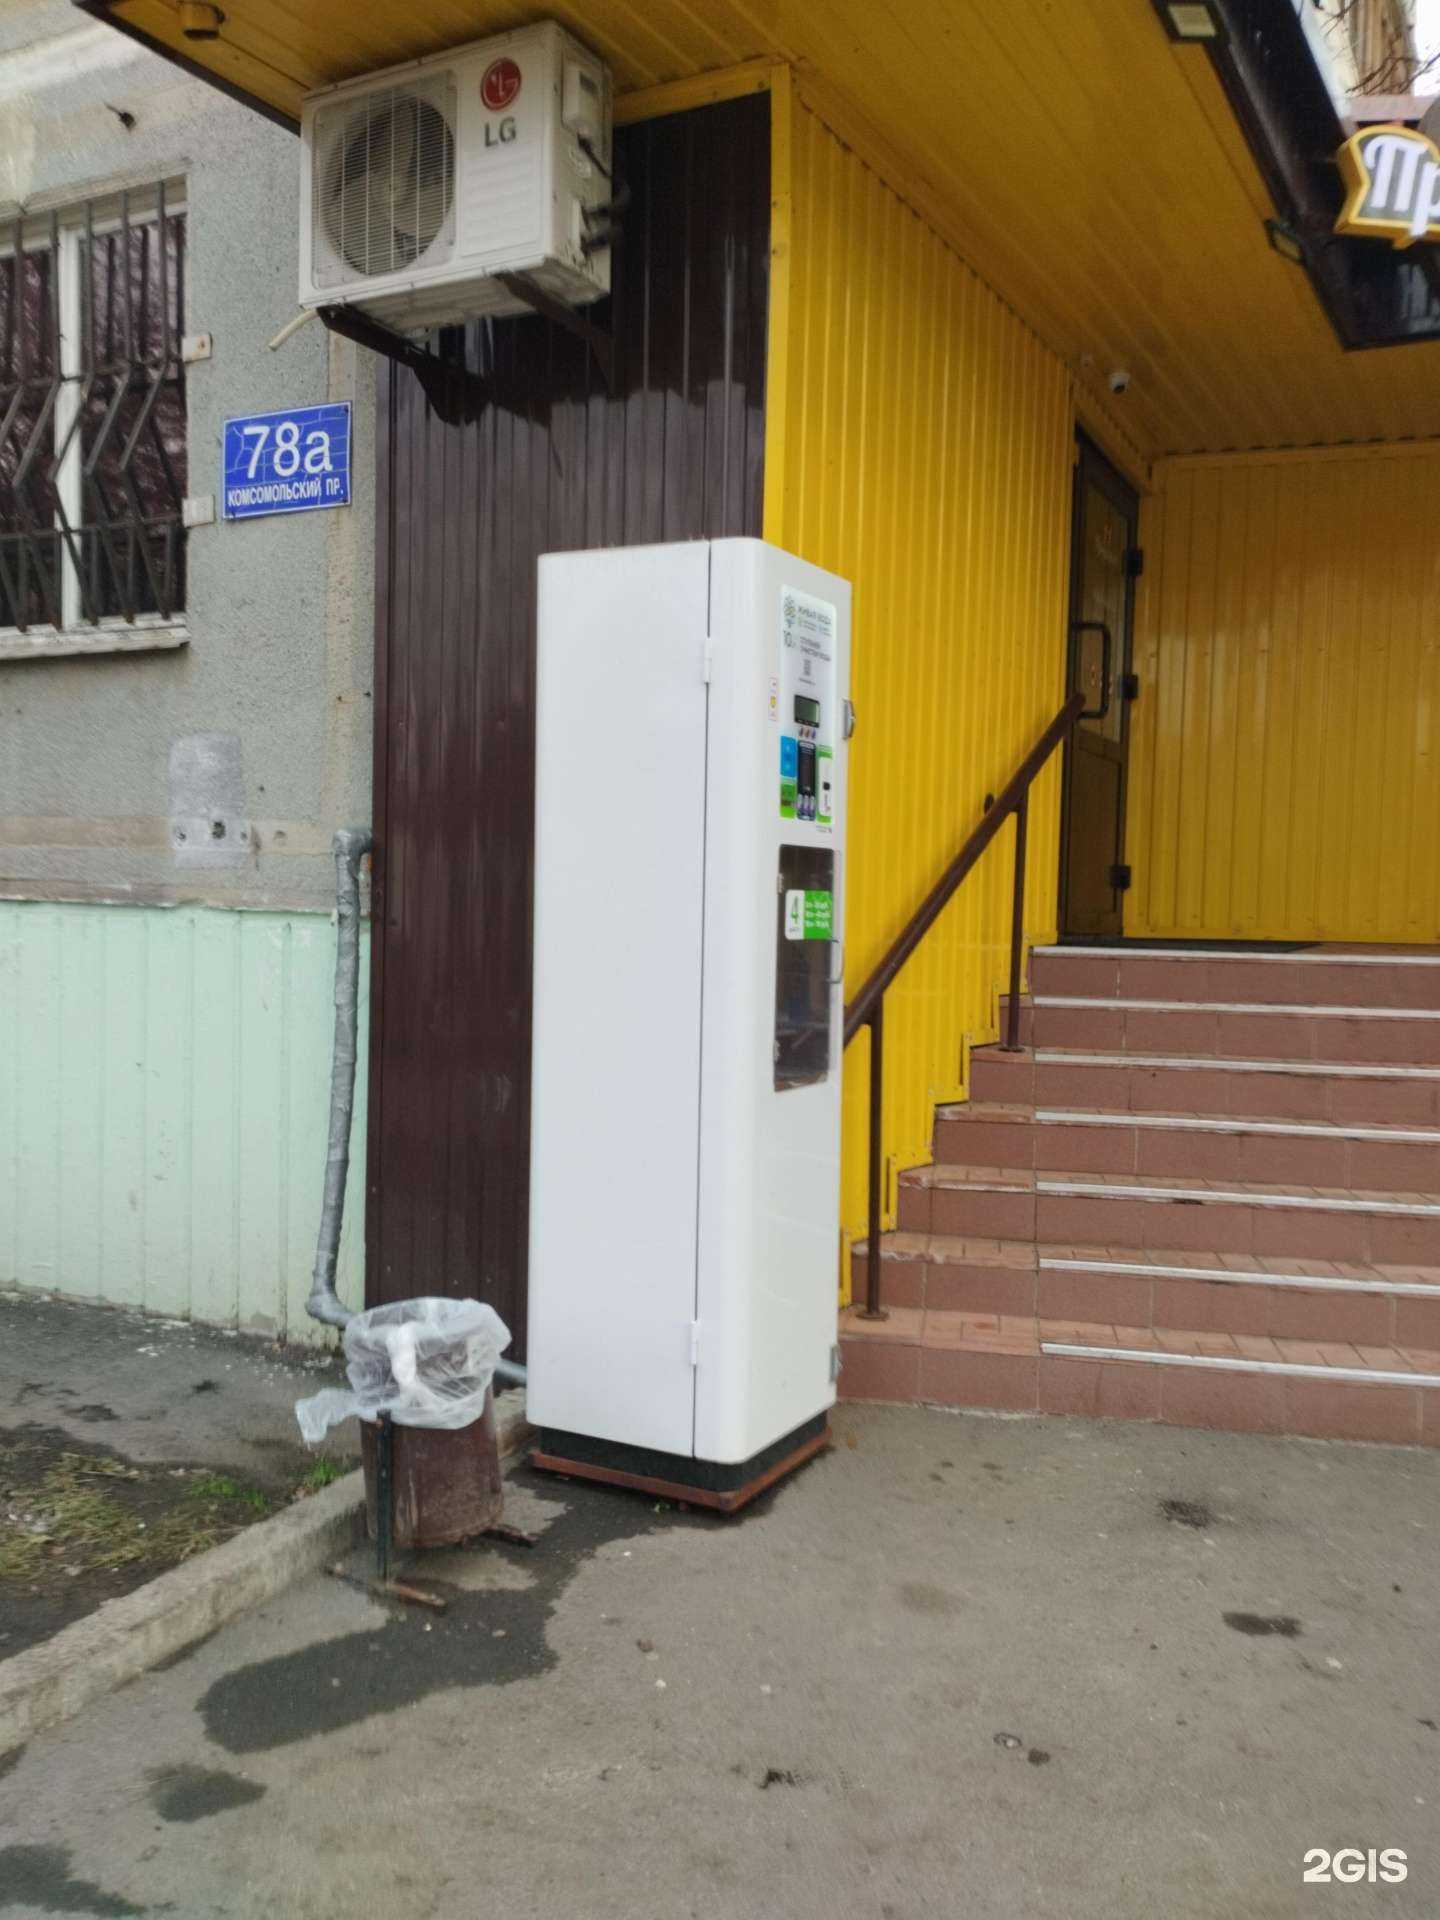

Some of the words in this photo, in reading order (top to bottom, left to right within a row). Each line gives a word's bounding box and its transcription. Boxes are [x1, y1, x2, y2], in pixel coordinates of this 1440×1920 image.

[484, 116, 517, 148] LG
[243, 421, 333, 479] 78а
[228, 478, 321, 507] КОМСОМОЛЬСКИЙ
[326, 478, 344, 496] ПР.
